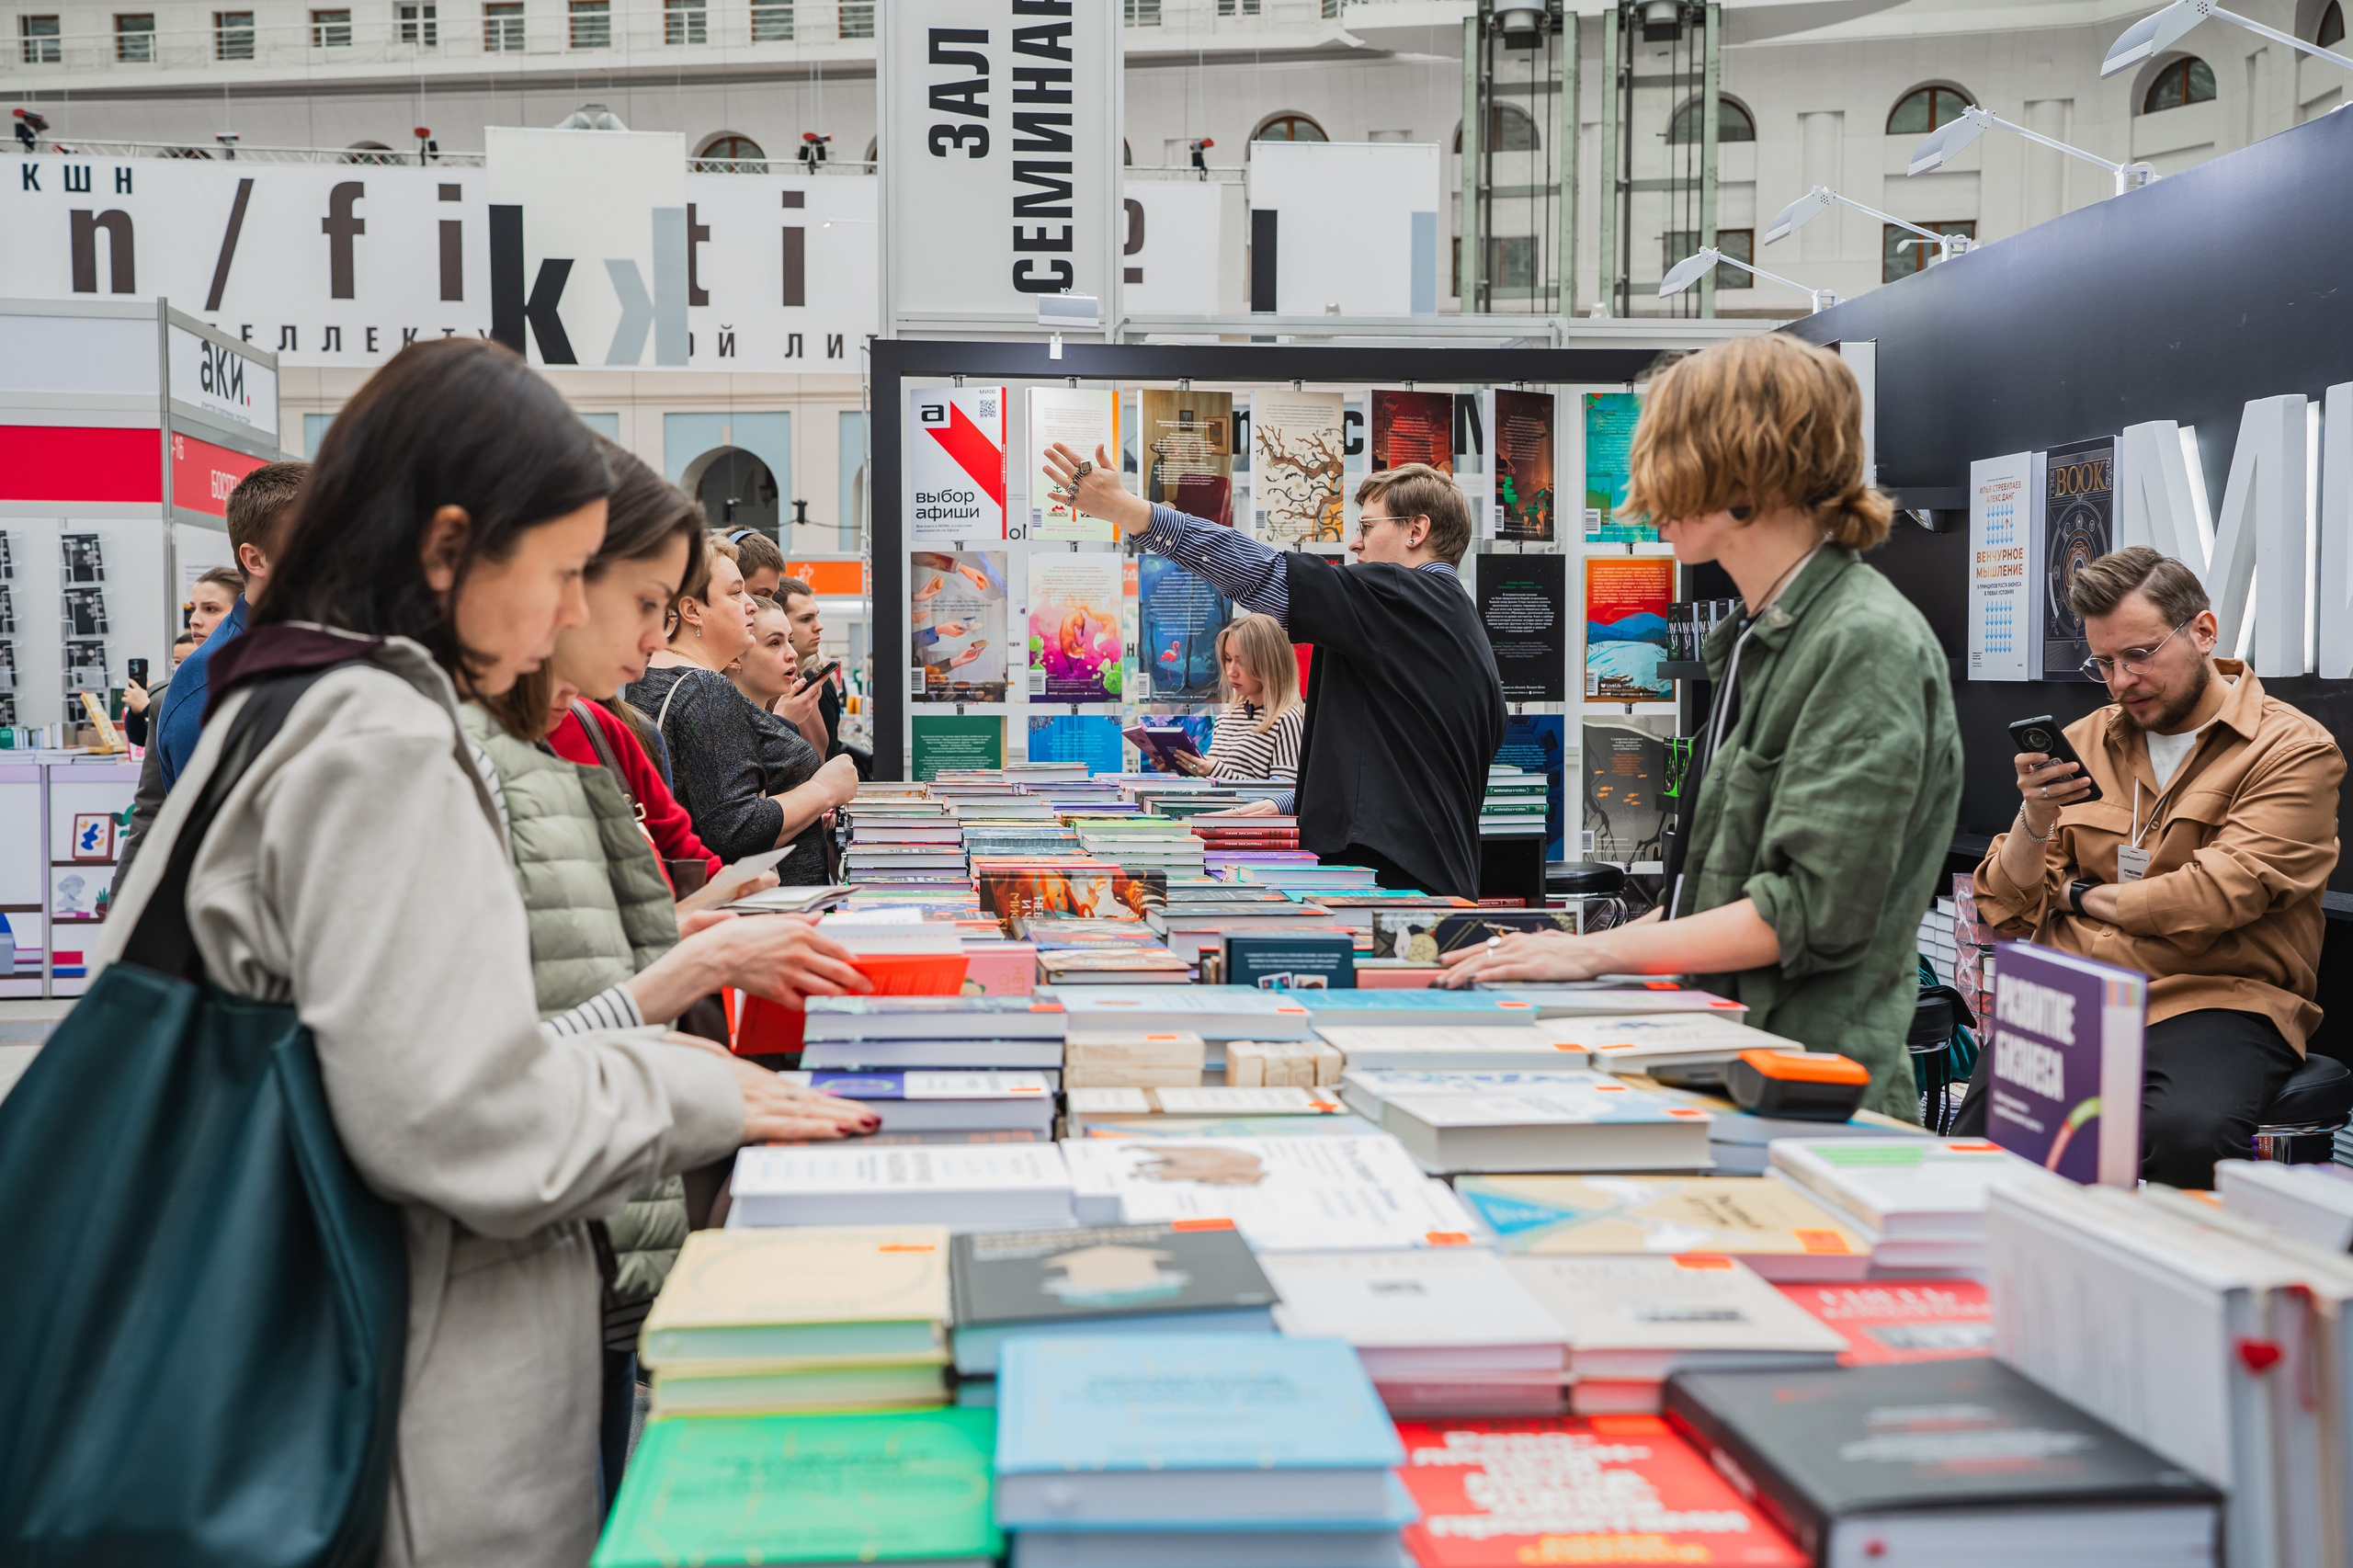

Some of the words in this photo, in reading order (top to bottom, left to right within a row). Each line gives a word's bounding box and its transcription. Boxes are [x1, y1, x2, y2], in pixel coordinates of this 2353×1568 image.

[927, 28, 989, 158] ЗАЛ
[2055, 460, 2107, 496] BOOK
[915, 489, 975, 505] выбор
[915, 505, 980, 522] афиши
[1976, 547, 2023, 563] ВЕНЧУРНОЕ
[1976, 563, 2023, 579] МЫШЛЕНИЕ
[1995, 1029, 2064, 1103] БИЗНЕСА
